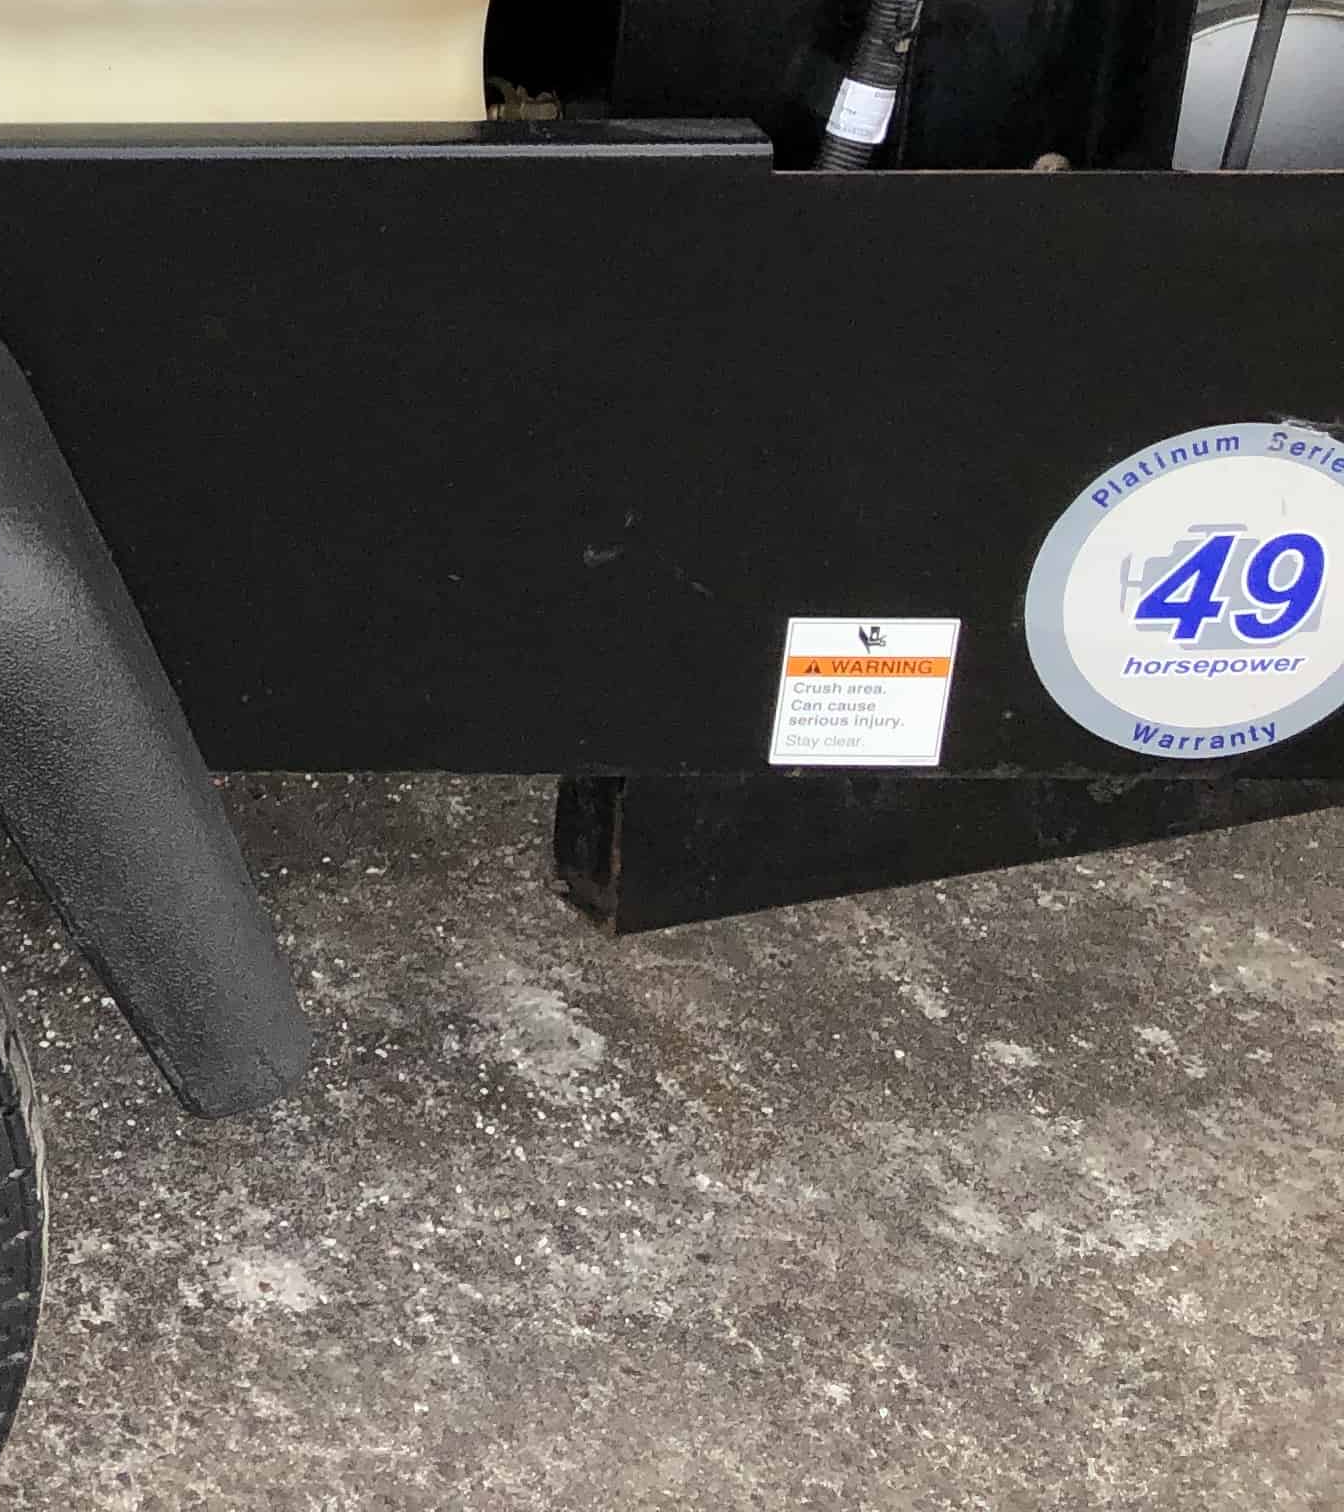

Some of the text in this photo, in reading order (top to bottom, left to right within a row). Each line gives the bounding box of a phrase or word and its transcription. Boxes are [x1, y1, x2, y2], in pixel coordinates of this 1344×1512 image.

[1092, 431, 1344, 508] Platinum Serie
[1134, 533, 1325, 640] 49
[832, 660, 932, 673] WARNING
[1122, 656, 1304, 677] horsepower
[794, 682, 886, 694] Crush area.
[792, 700, 876, 711] Can cause
[789, 716, 904, 729] serious injury.
[786, 735, 864, 749] Stay clear.
[1132, 722, 1276, 751] Warranty
